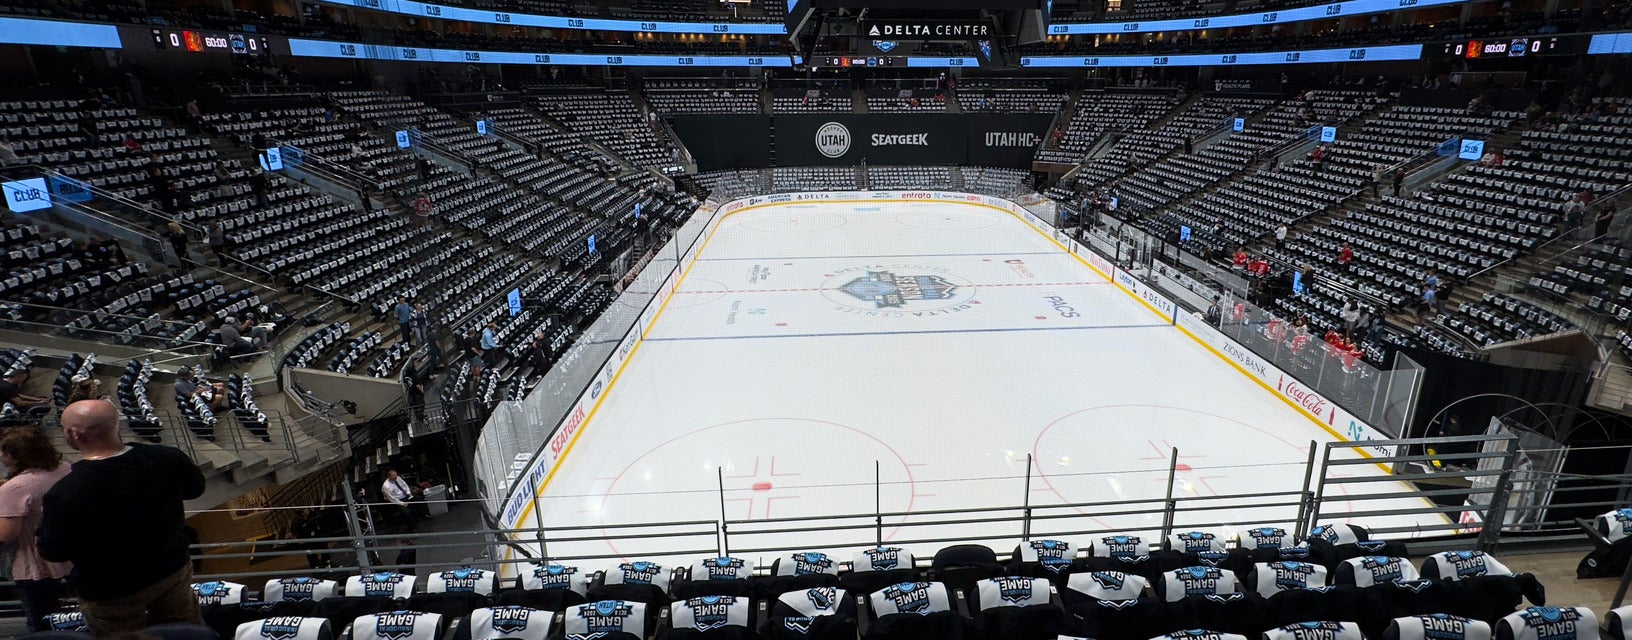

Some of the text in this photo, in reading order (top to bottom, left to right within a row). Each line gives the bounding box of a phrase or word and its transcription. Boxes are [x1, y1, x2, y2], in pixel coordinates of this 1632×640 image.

[426, 6, 441, 16] CLUB
[1326, 5, 1341, 15] CLUB
[496, 14, 510, 22] CLUB
[1263, 13, 1277, 22] CLUB
[568, 19, 584, 27] CLUB
[1194, 19, 1209, 28] CLUB
[884, 24, 987, 35] DELTA CENTER
[170, 33, 179, 46] 0
[205, 38, 227, 47] 60:00
[249, 39, 256, 50] 0
[1455, 45, 1462, 55] 0
[1484, 44, 1506, 52] 60:00
[1531, 41, 1540, 52] 0
[466, 52, 480, 61] CLUB
[1222, 55, 1236, 63] CLUB
[1286, 52, 1300, 61] CLUB
[1350, 50, 1365, 59] CLUB
[822, 135, 845, 146] UTAH
[871, 133, 928, 146] SEATGEEK
[986, 132, 1041, 147] UTAH HC+
[1149, 293, 1170, 312] DELTA
[1223, 342, 1267, 377] ZIONS BANK
[551, 401, 586, 460] SEATGEEK
[507, 460, 545, 525] BUD LIHT
[1258, 536, 1280, 544] GAME
[872, 551, 896, 562] GAME
[1038, 549, 1061, 557] GAME
[798, 561, 822, 574] GAME
[1456, 556, 1484, 569] GAME
[710, 566, 735, 575] GAME
[1373, 562, 1399, 576] GAME
[542, 574, 569, 584] GAME
[625, 570, 651, 581] GAME
[1278, 570, 1306, 582] GAME
[284, 584, 312, 592] GAME
[366, 582, 393, 590] GAME
[447, 579, 473, 587] GAME
[1001, 580, 1030, 590] GAME
[1186, 580, 1214, 589] GAME
[897, 589, 926, 608] GAME
[494, 609, 528, 620] GAME
[695, 604, 726, 616] GAME
[264, 616, 302, 626] GAME
[378, 615, 414, 626] GAME
[588, 616, 621, 626] GAME
[1423, 617, 1464, 633] GAME
[1538, 620, 1574, 637] GAME
[1296, 629, 1333, 640] GAME
